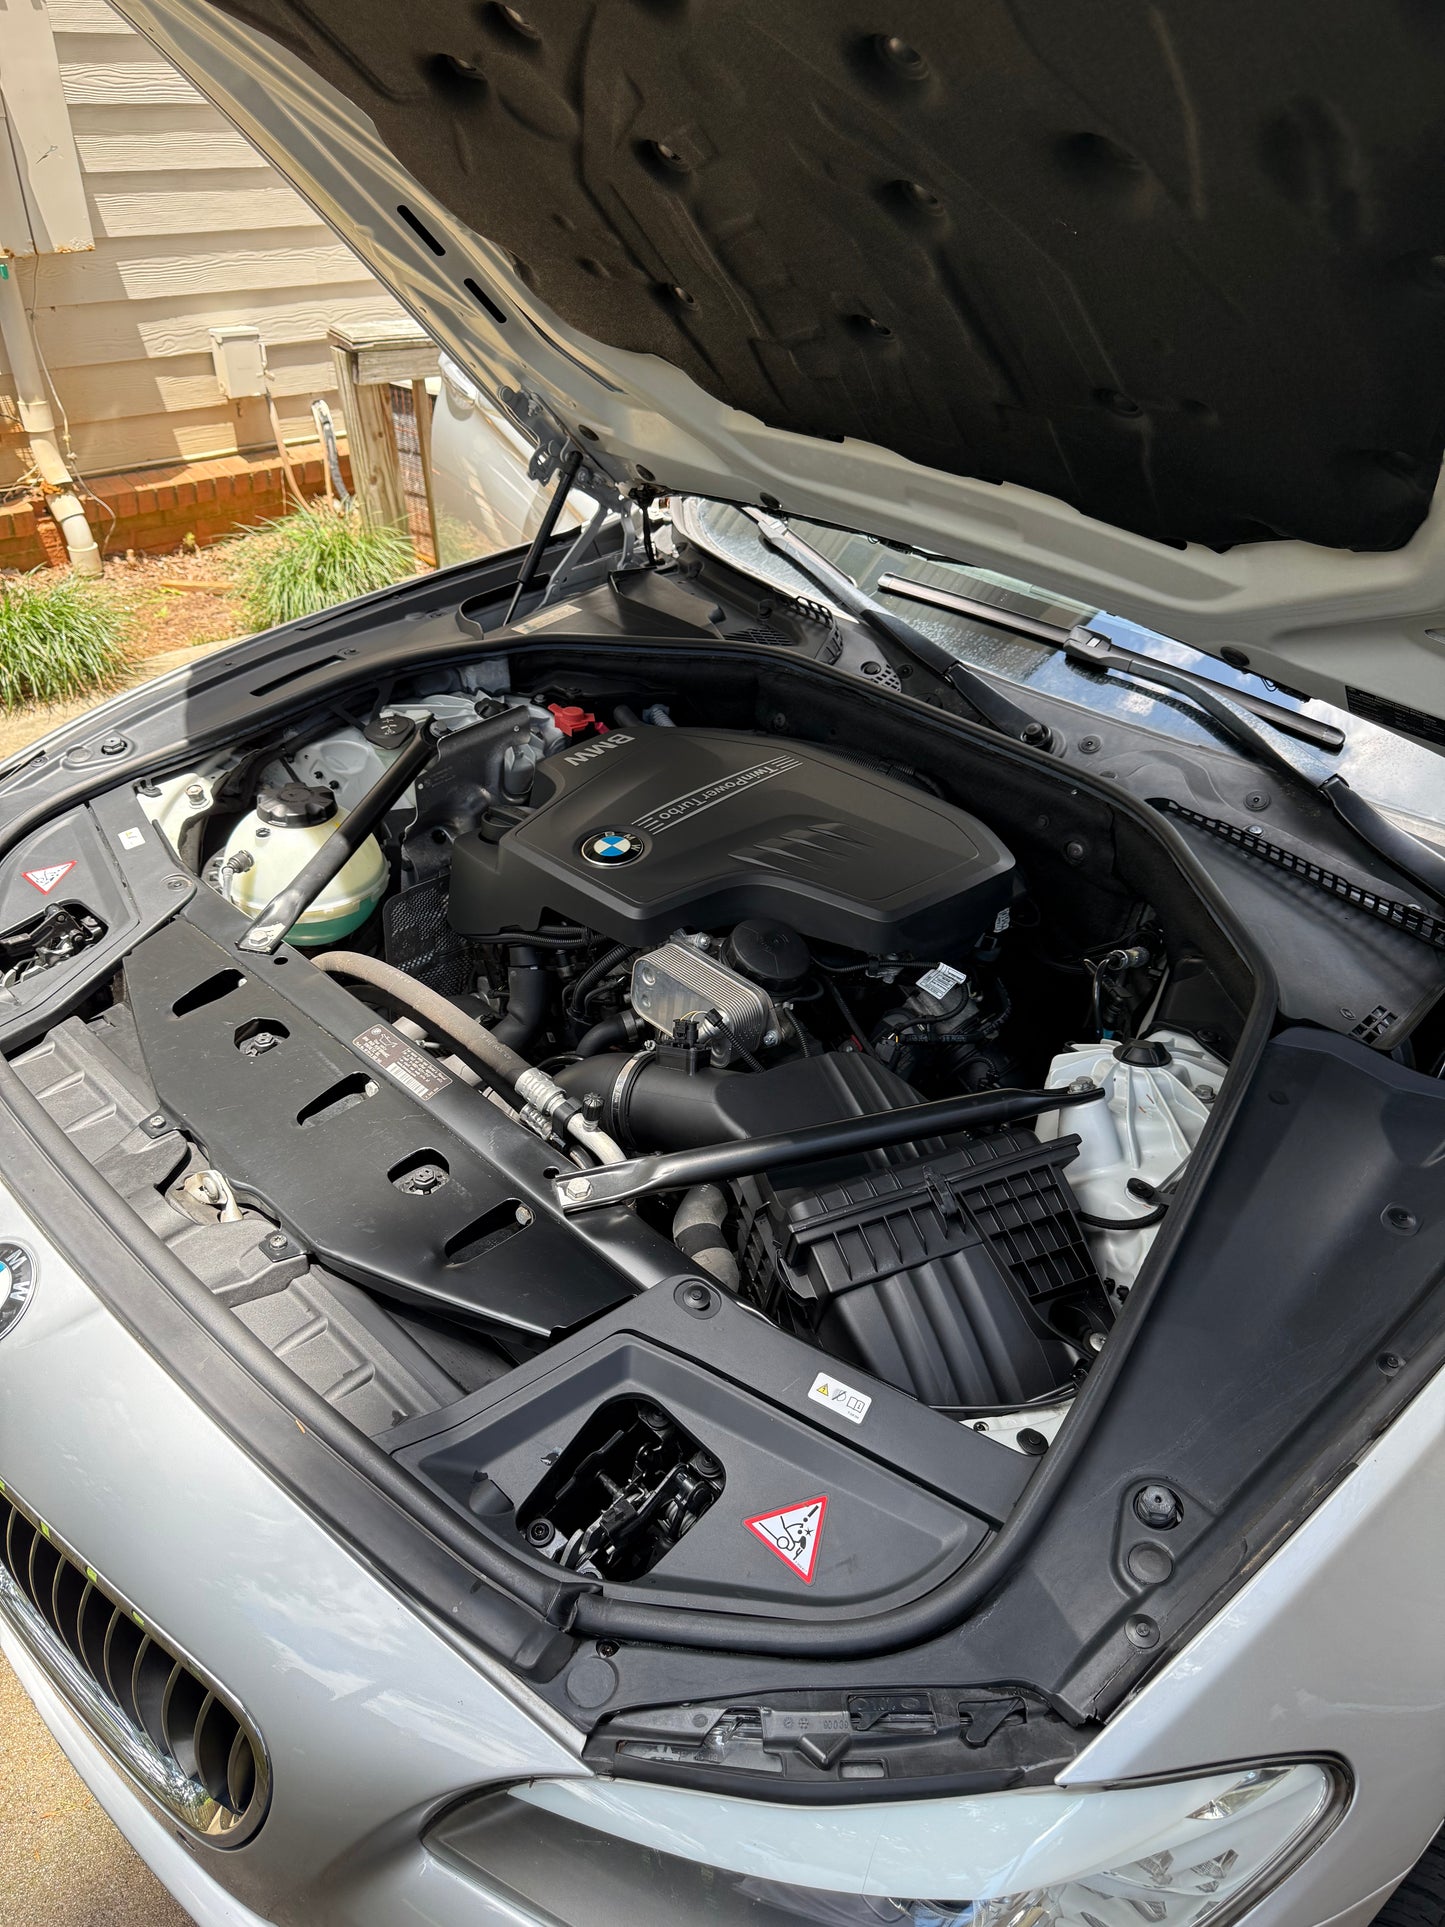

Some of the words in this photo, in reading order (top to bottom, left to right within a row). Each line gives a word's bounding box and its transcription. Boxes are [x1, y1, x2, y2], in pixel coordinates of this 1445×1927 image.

[564, 734, 635, 766] BMW
[701, 766, 779, 800] TwinPower
[659, 798, 707, 820] Turbo
